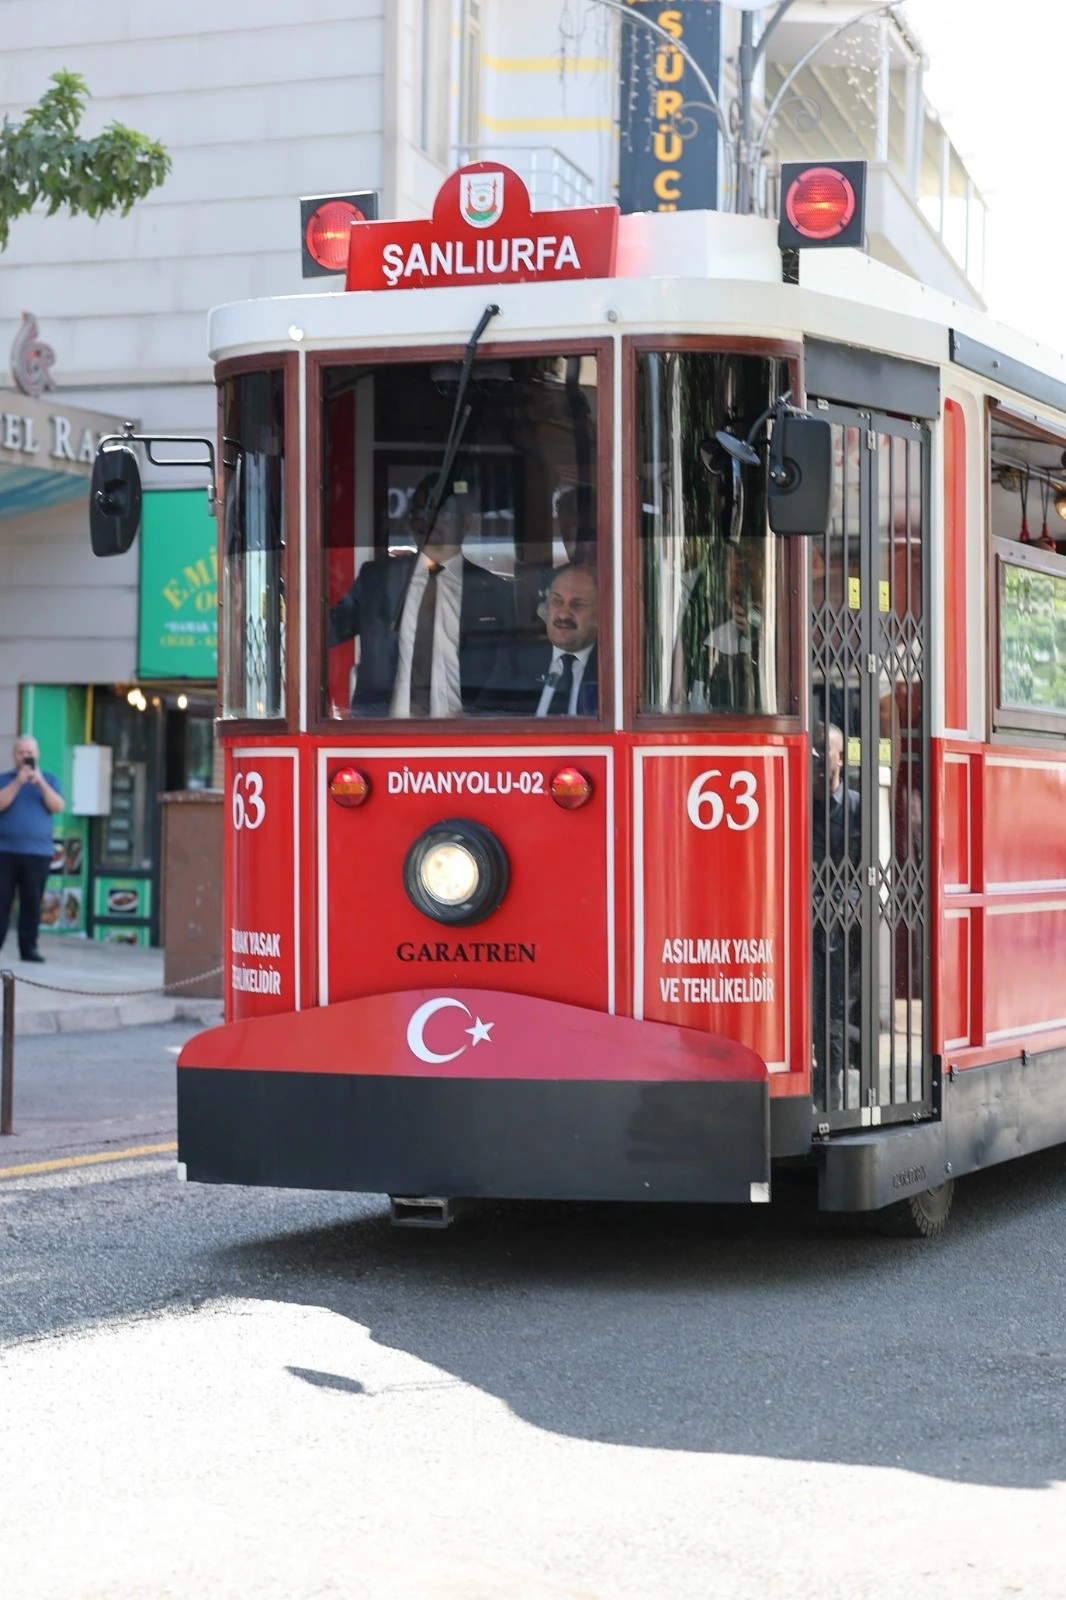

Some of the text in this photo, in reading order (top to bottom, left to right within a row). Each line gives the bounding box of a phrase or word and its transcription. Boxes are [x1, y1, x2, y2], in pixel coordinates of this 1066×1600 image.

[653, 9, 684, 213] SÜRÜC
[382, 235, 581, 287] ŞANLIURFA
[0, 412, 40, 454] EL
[162, 546, 218, 612] EMİ
[233, 771, 266, 830] 63
[388, 766, 544, 794] DİVANYOLU-02
[687, 769, 759, 831] 63
[249, 931, 281, 958] YASAK
[396, 942, 536, 962] GARATREN
[661, 938, 773, 964] ASILMAK YASAK
[659, 971, 775, 1003] VE TEHLİKELİDİR
